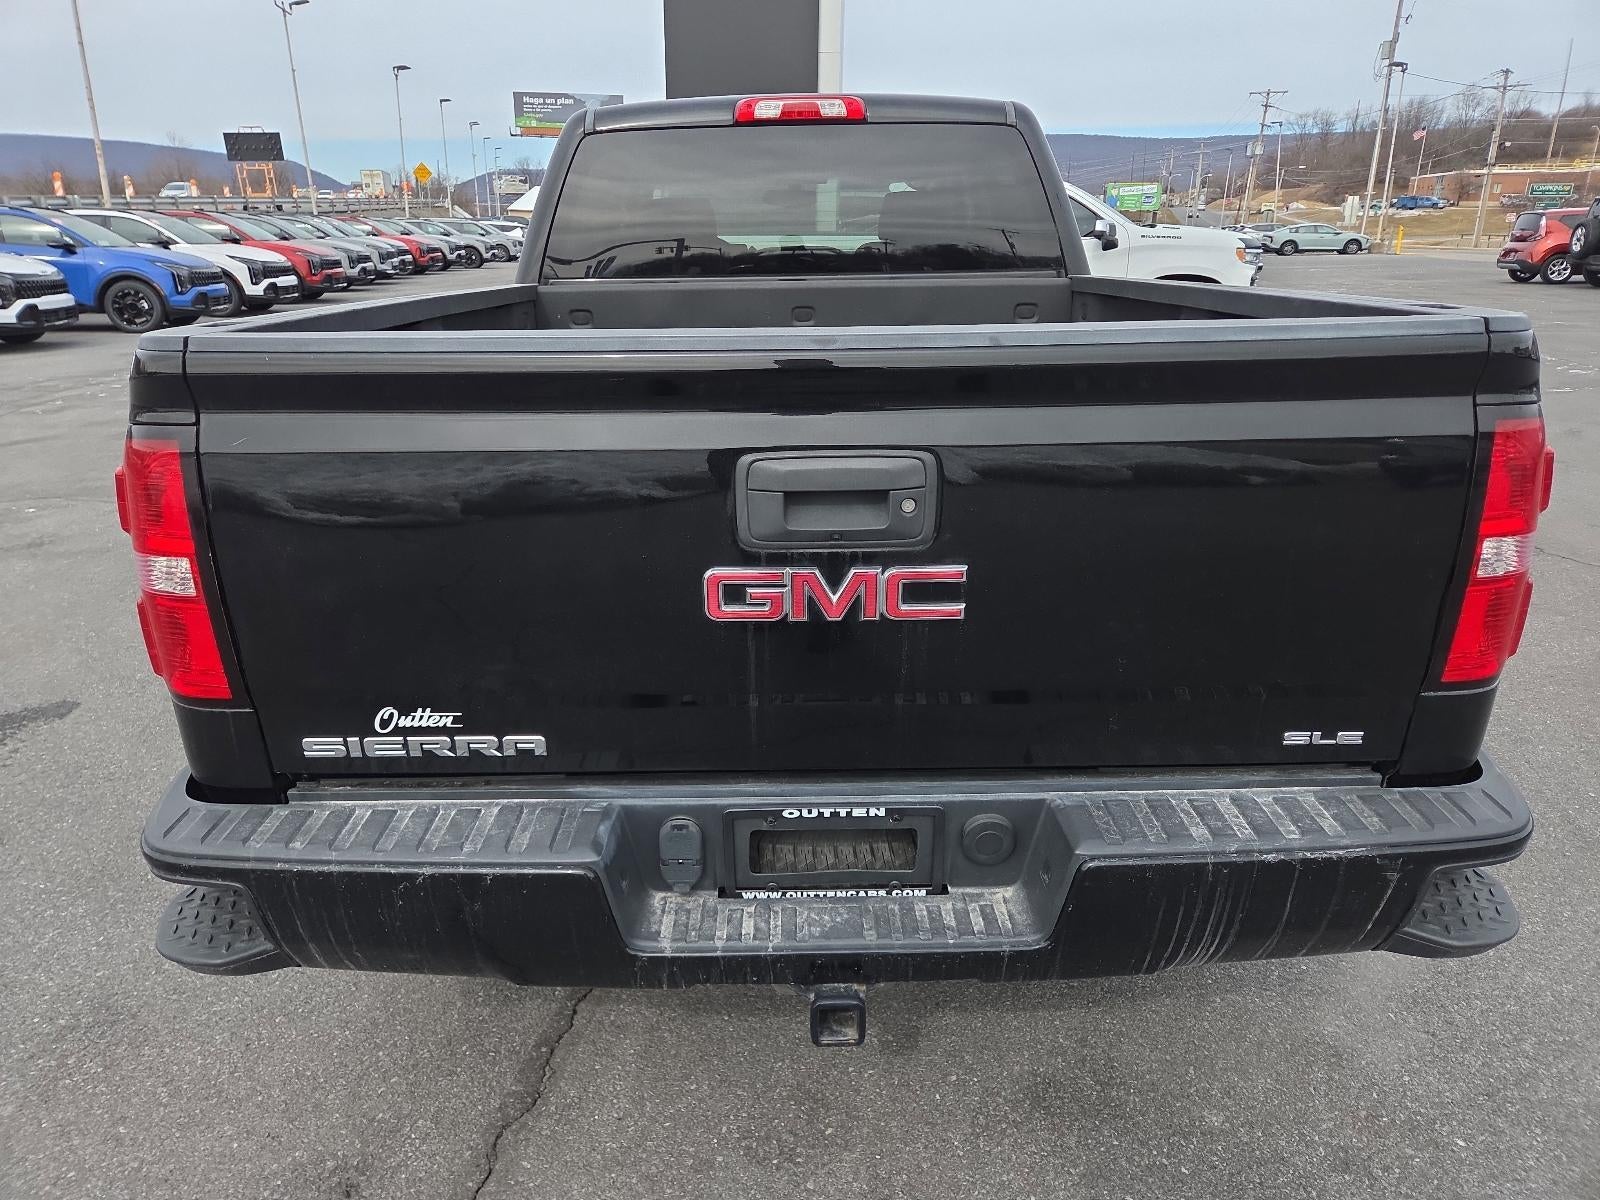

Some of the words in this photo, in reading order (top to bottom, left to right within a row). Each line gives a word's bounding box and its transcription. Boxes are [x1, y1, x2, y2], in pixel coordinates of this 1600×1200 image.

[523, 96, 544, 105] Haga
[557, 97, 574, 106] plan
[704, 565, 968, 621] GMC
[374, 706, 463, 733] Outten
[302, 735, 547, 757] SIERRA
[1283, 731, 1364, 745] SLE
[782, 807, 886, 819] OUTTEN
